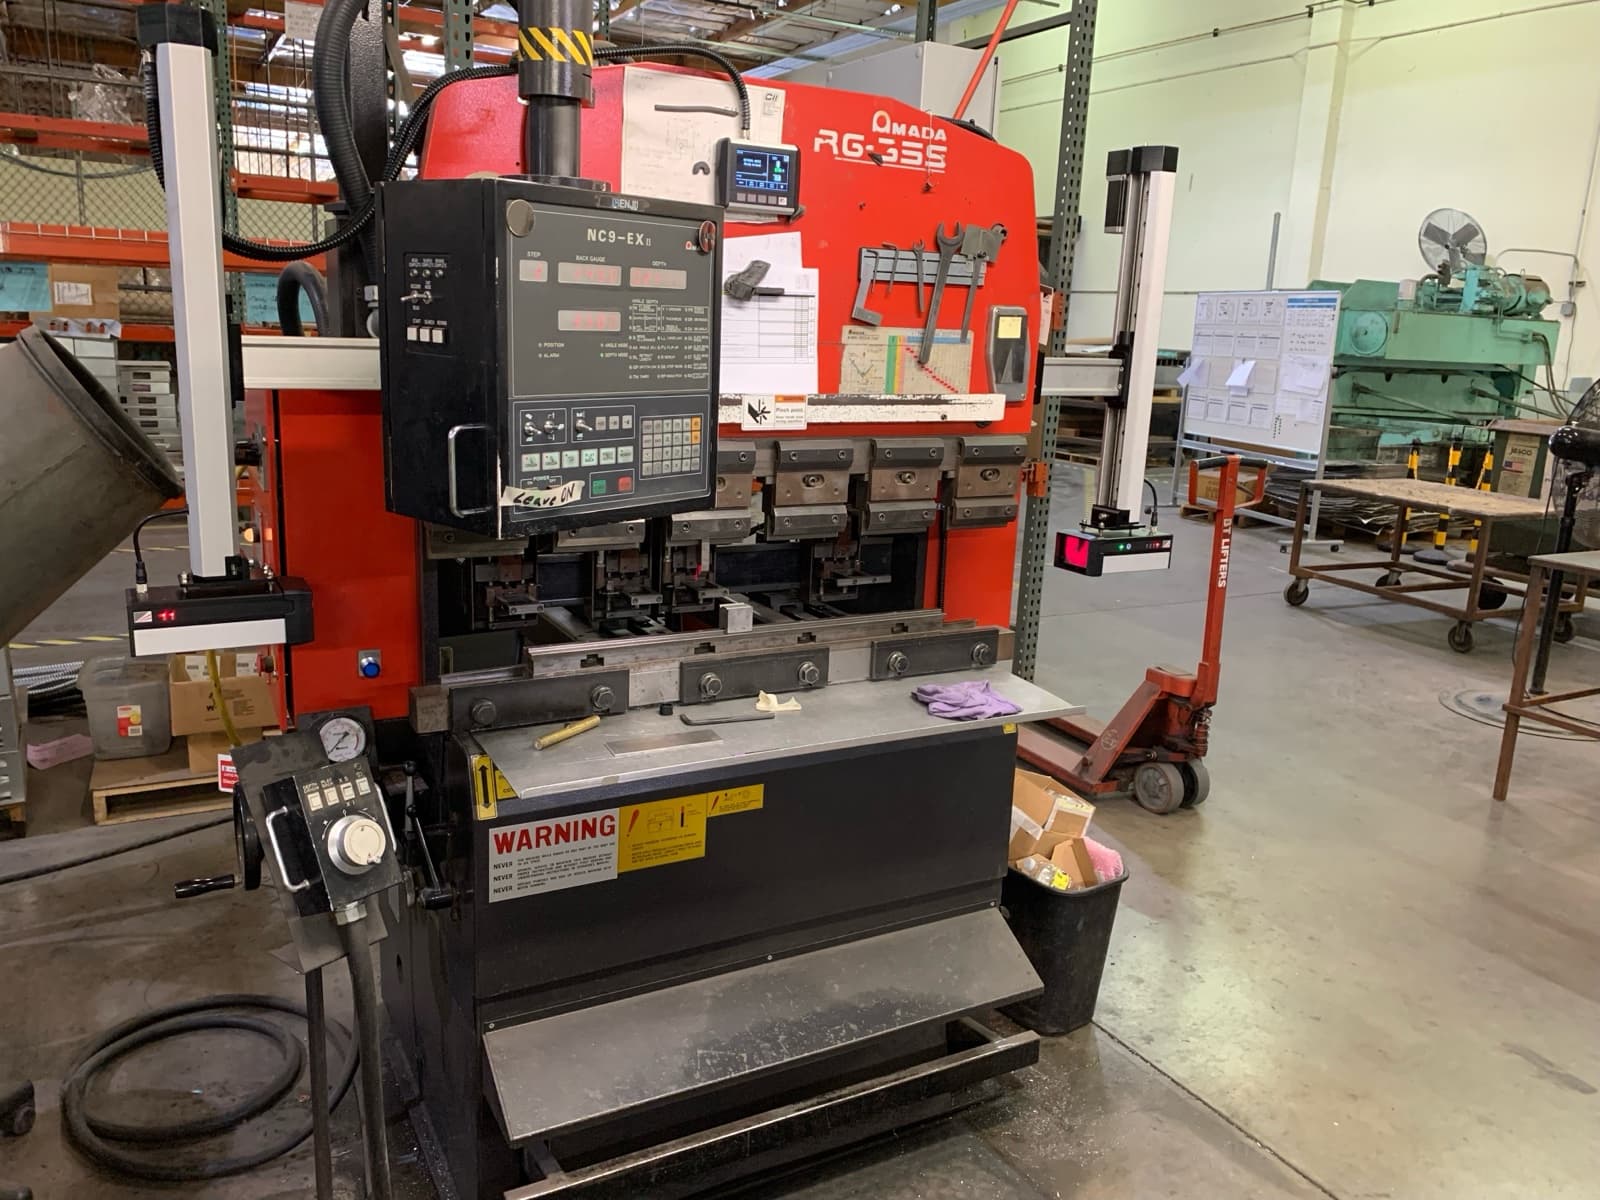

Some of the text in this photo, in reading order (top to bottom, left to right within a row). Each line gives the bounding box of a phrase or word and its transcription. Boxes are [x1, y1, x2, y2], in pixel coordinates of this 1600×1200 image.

[1217, 538, 1231, 588] LIFTERS
[493, 814, 616, 855] WARNING
[493, 861, 513, 870] NEVER
[493, 873, 513, 882] NEVER
[493, 885, 513, 894] NEVER
